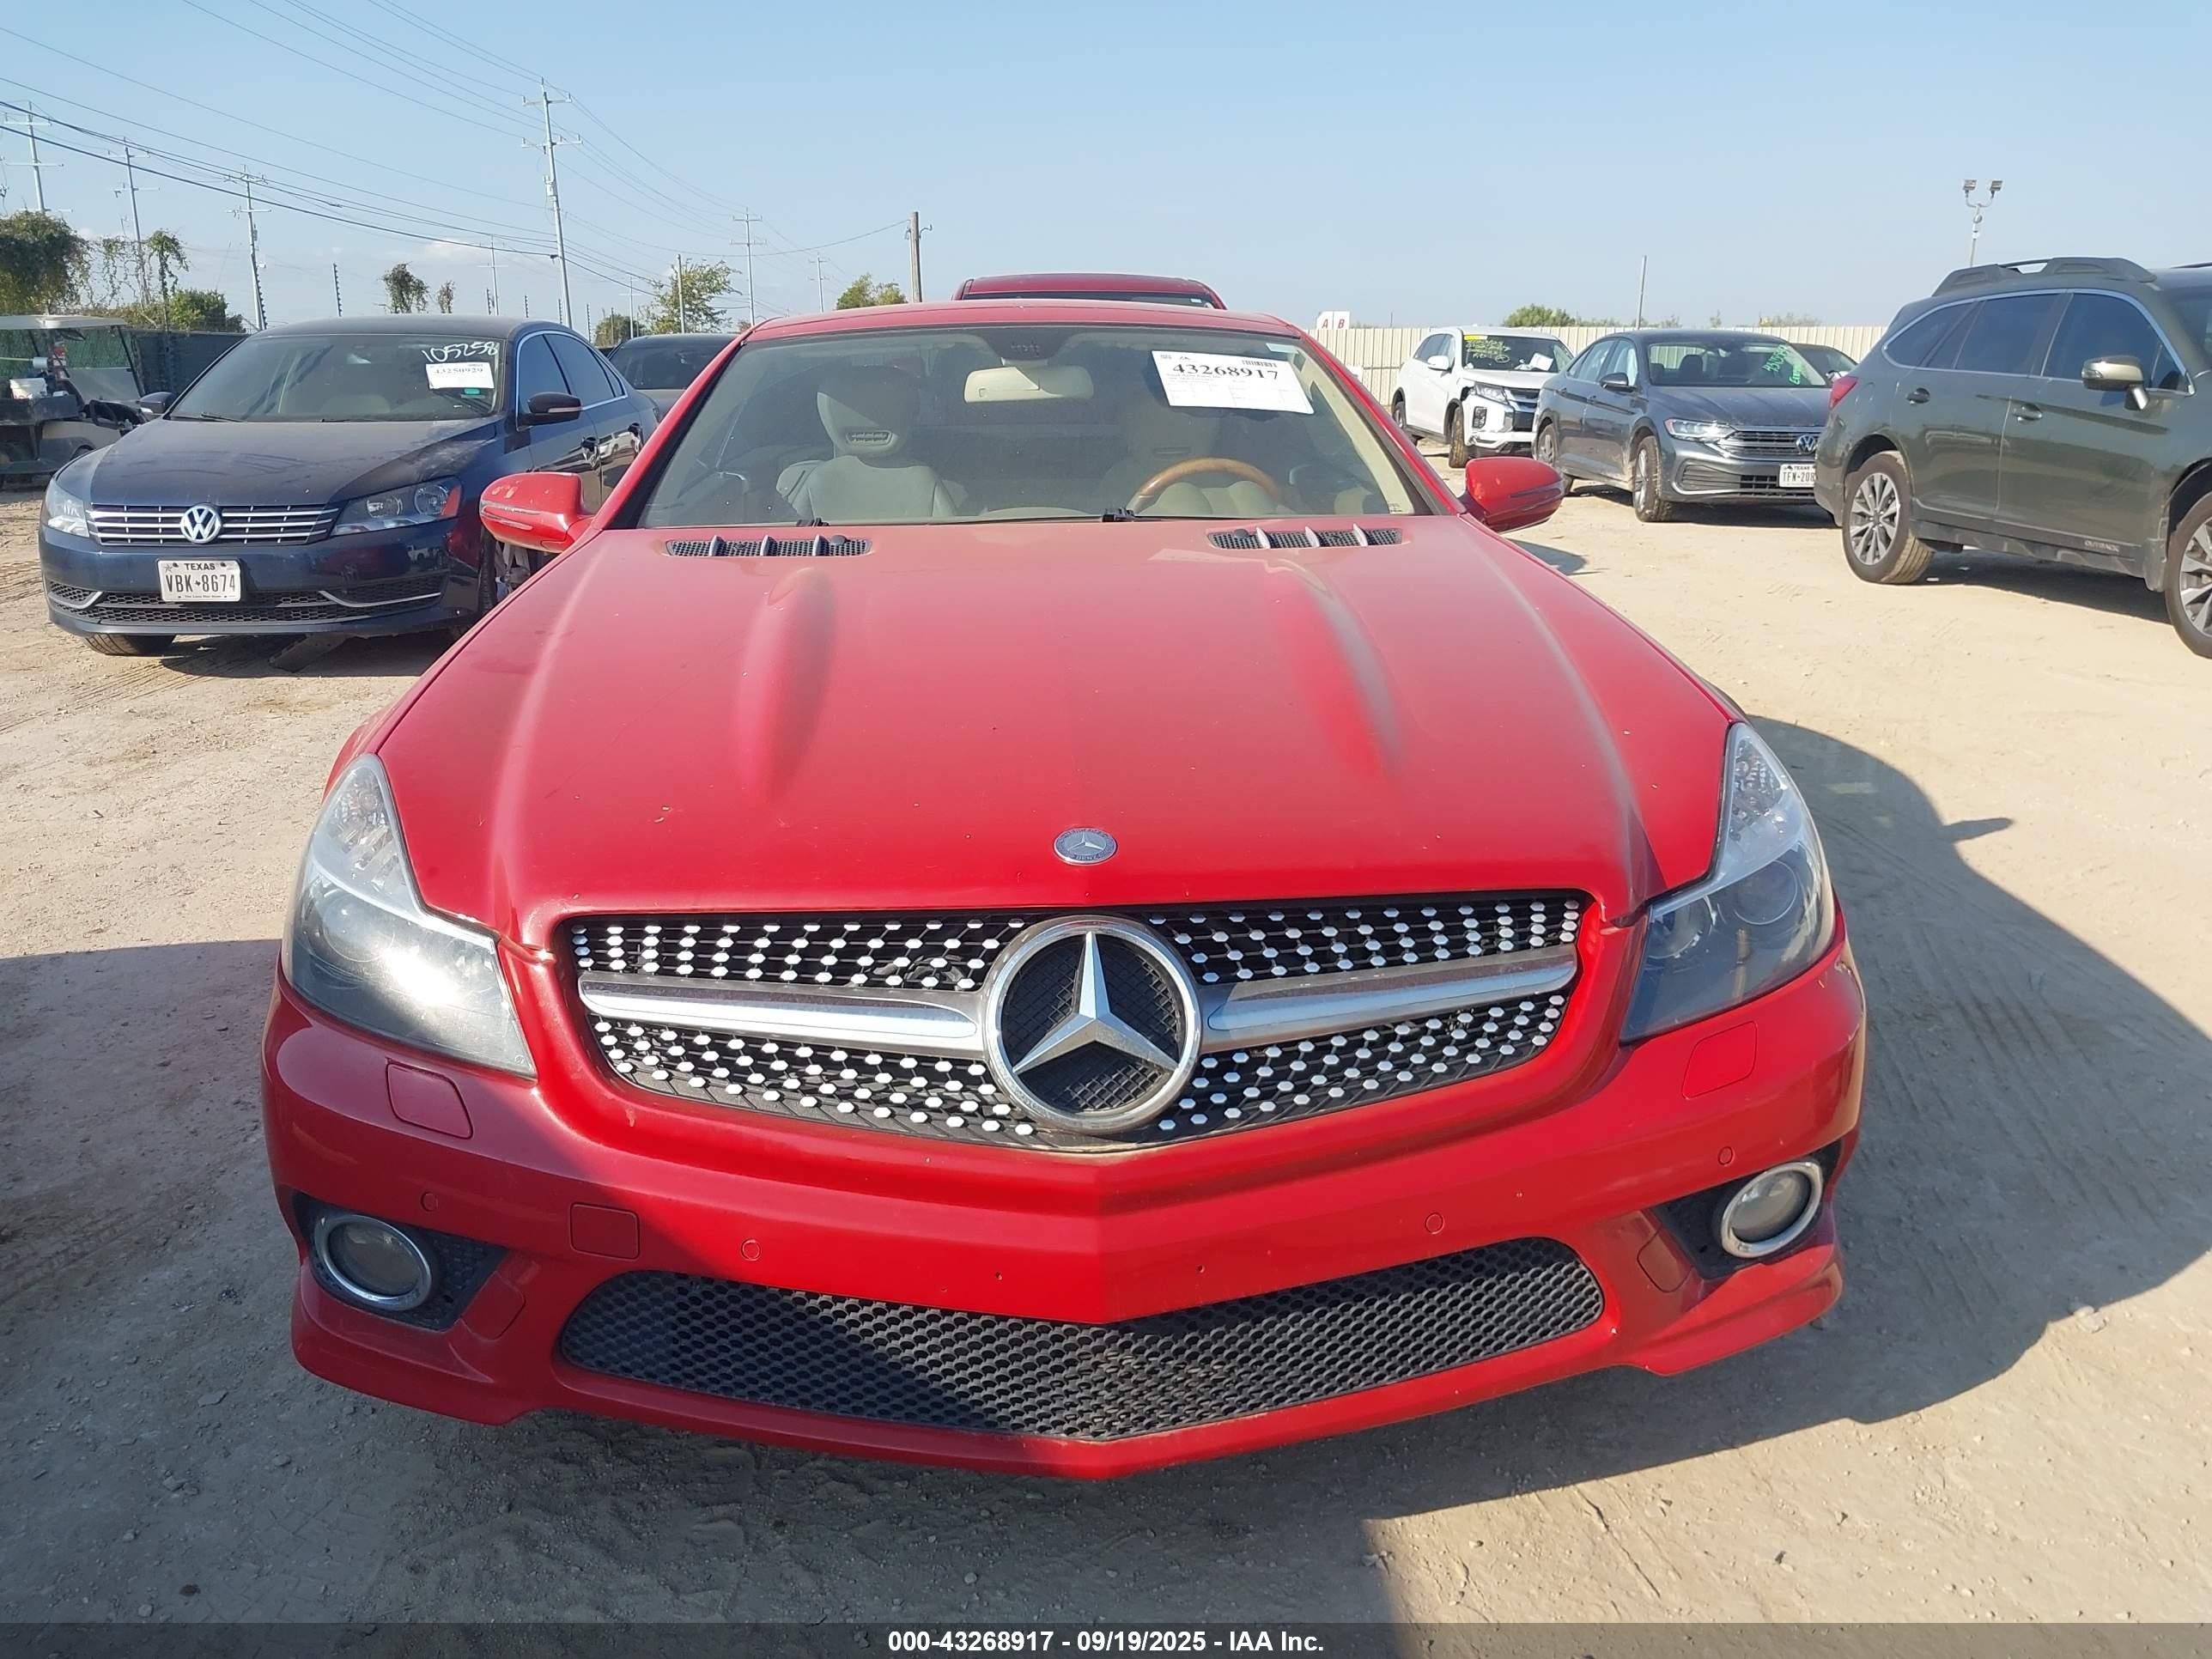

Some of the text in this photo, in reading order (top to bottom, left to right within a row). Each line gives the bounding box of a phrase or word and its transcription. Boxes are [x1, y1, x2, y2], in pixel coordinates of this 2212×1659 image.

[1322, 319, 1346, 329] A B
[421, 341, 498, 362] 105258
[1172, 363, 1279, 380] 43268917
